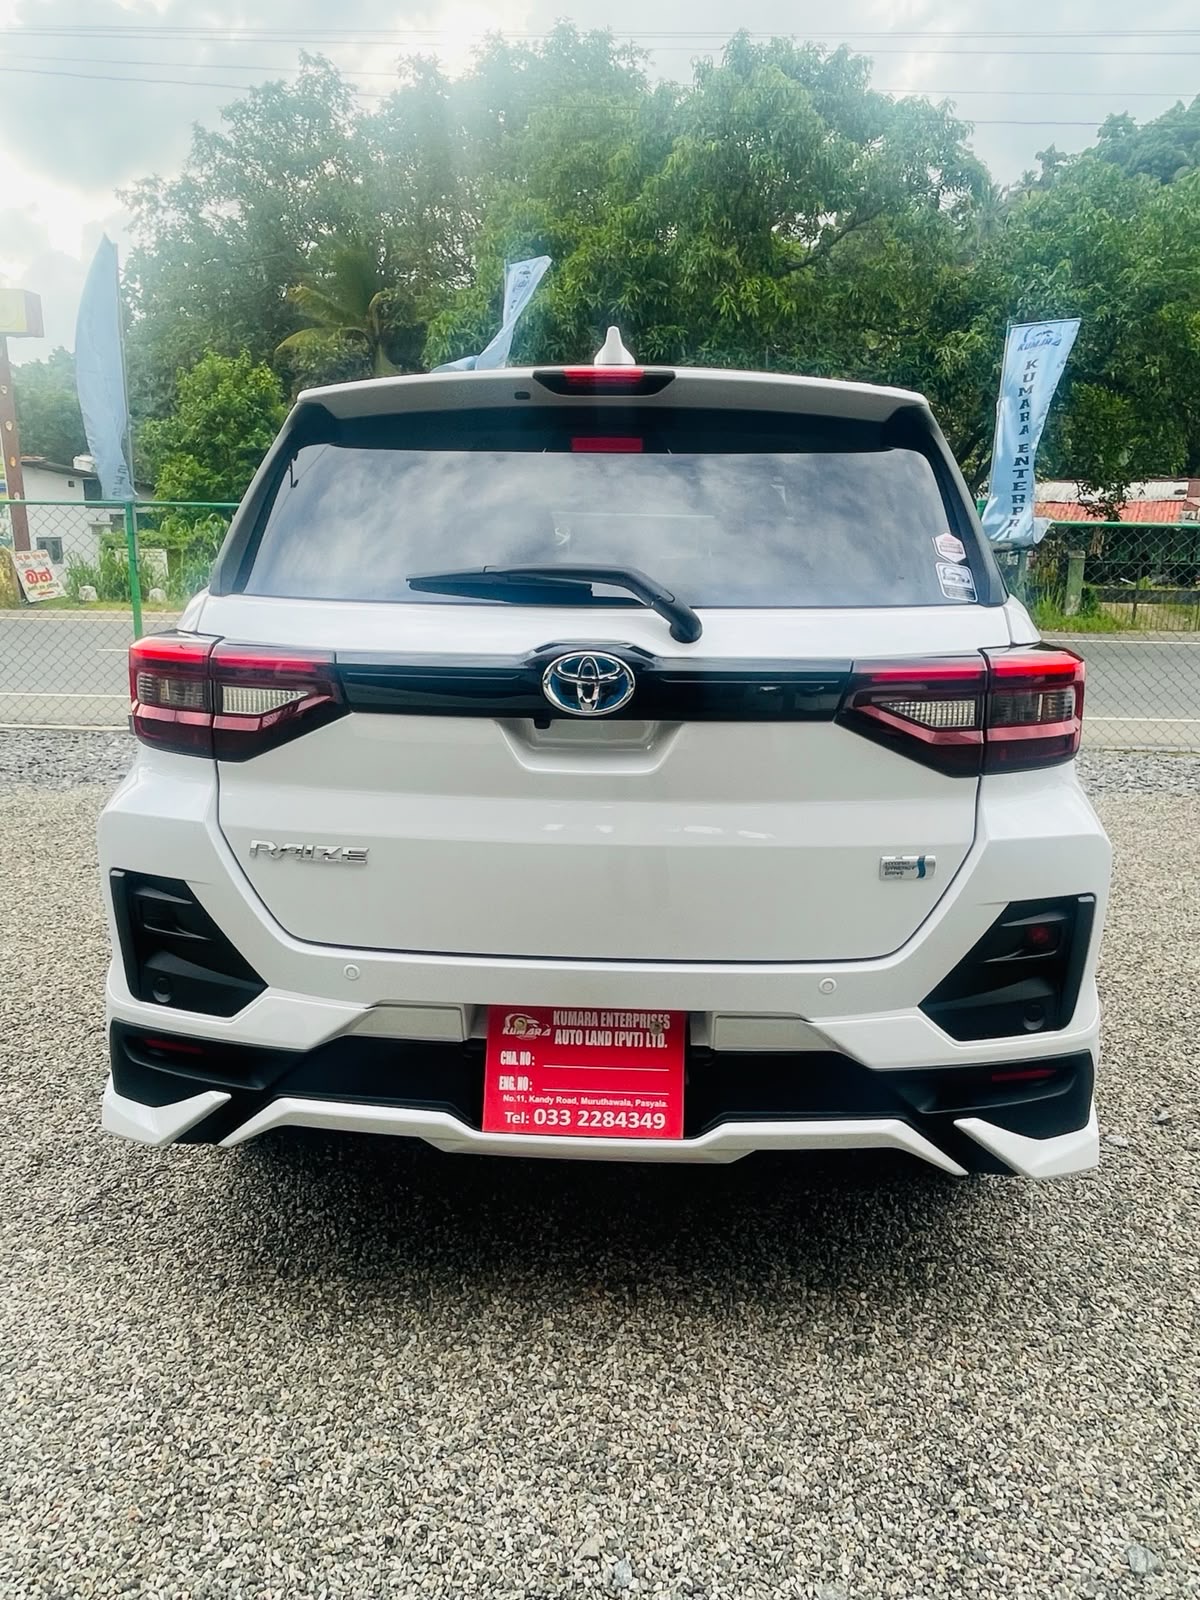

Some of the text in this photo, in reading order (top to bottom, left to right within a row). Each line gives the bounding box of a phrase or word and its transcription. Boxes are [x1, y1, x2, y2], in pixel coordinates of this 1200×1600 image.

[1017, 358, 1039, 436] KUMARA
[249, 839, 369, 864] RAIZE
[553, 1010, 599, 1027] KUMARA
[554, 1029, 668, 1048] AUTO LAND (PVT) LTD.
[503, 1094, 669, 1109] No.11, Kandy Road, Muruthawala, Pasyala.
[505, 1108, 666, 1130] Tel: 033 2284349
